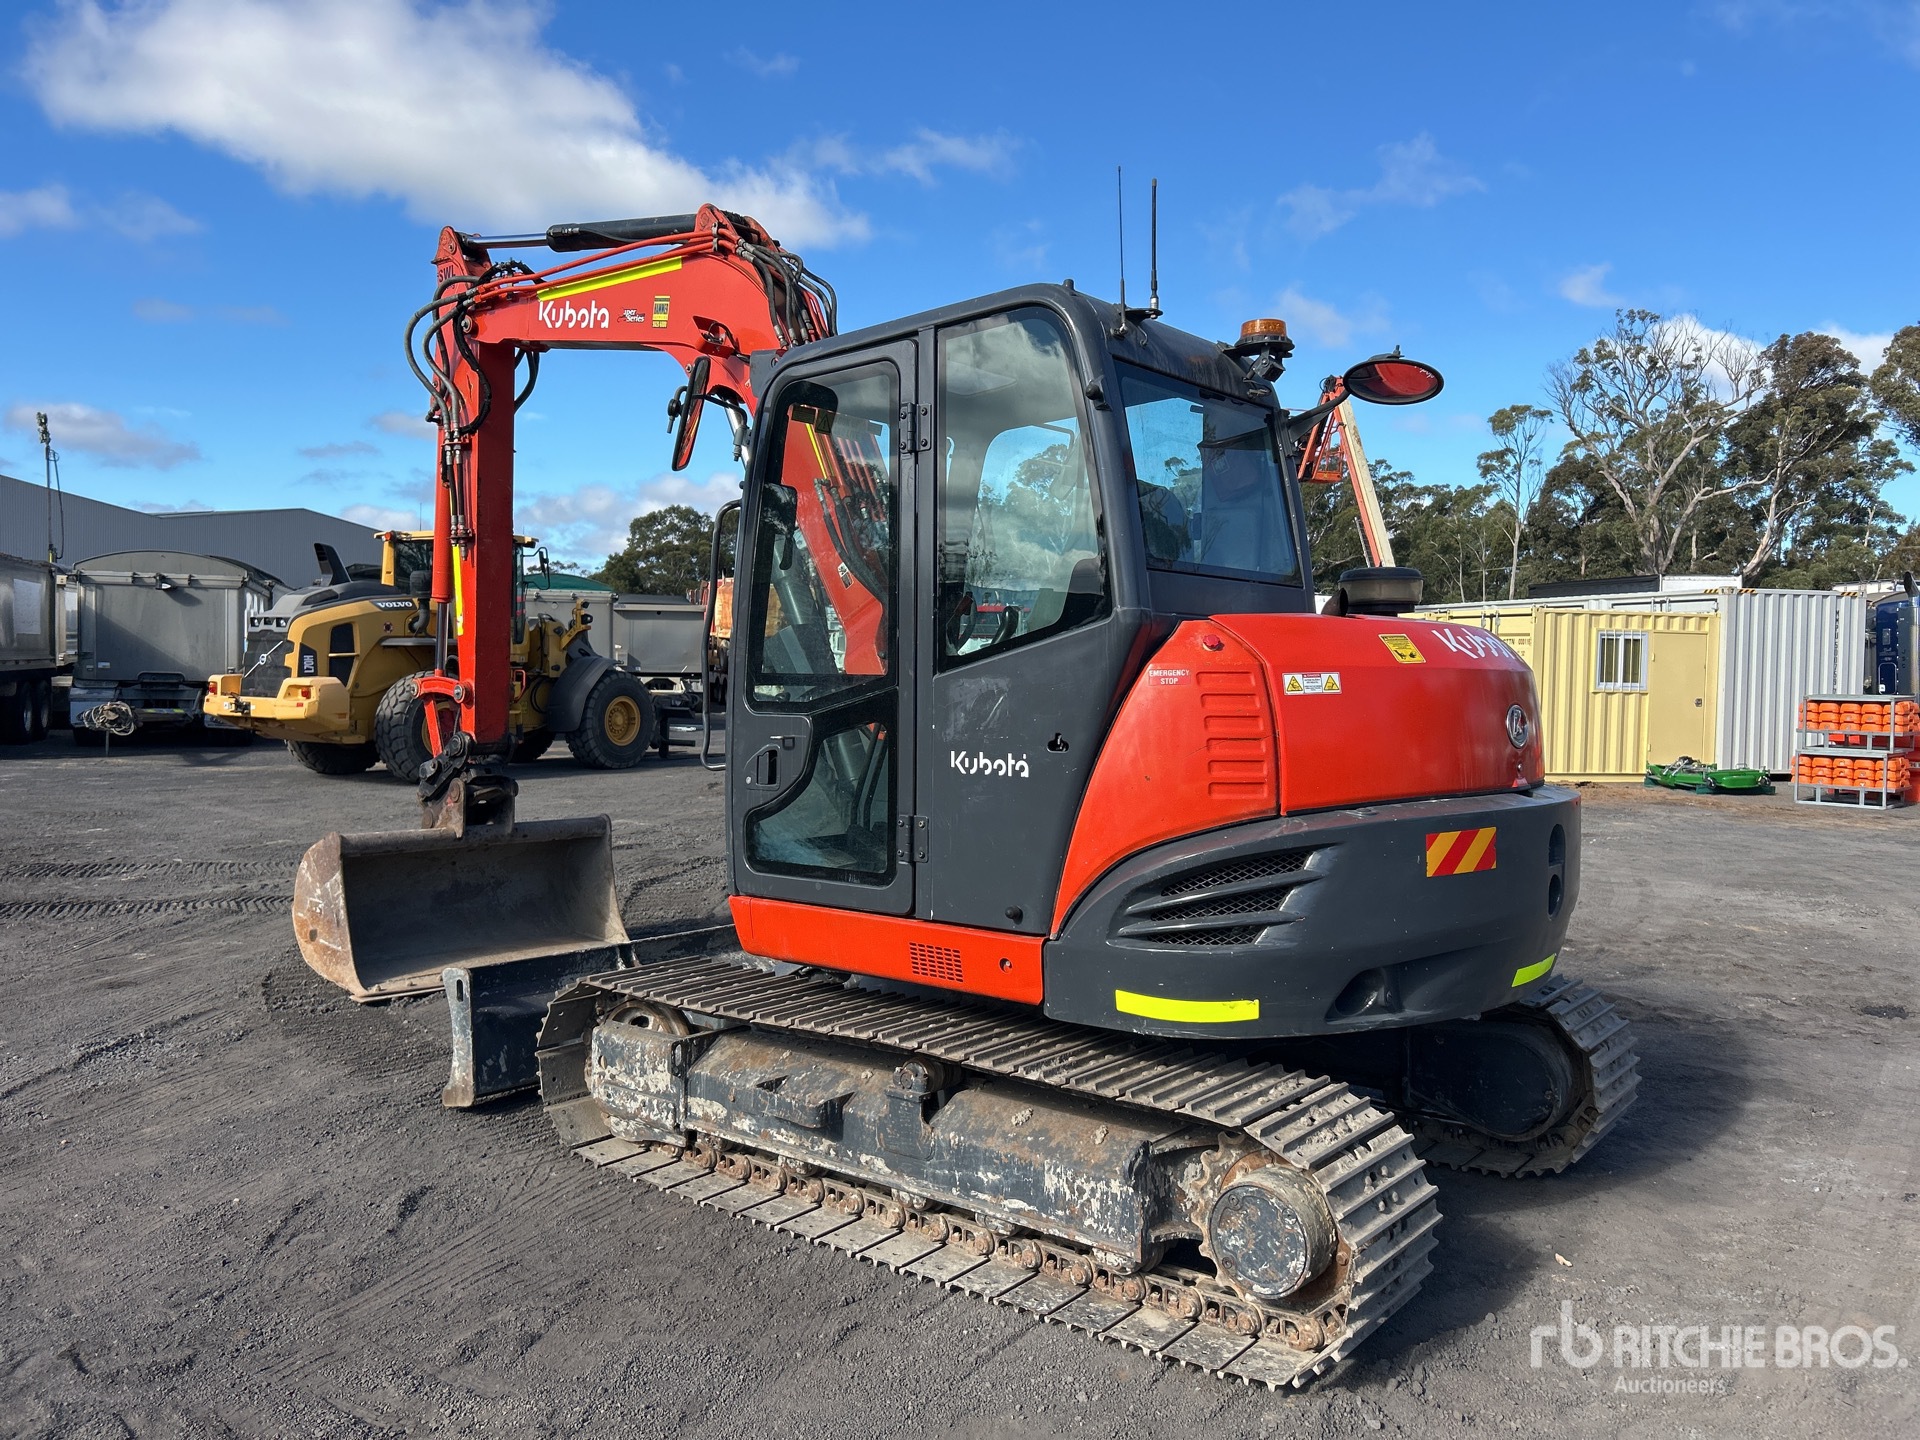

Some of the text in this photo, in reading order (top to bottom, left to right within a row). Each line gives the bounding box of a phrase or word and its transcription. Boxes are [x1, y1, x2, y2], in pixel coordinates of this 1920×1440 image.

[538, 300, 610, 329] Kubota
[303, 655, 314, 673] L70H
[1160, 677, 1179, 685] STOP
[950, 750, 1030, 778] Kubota
